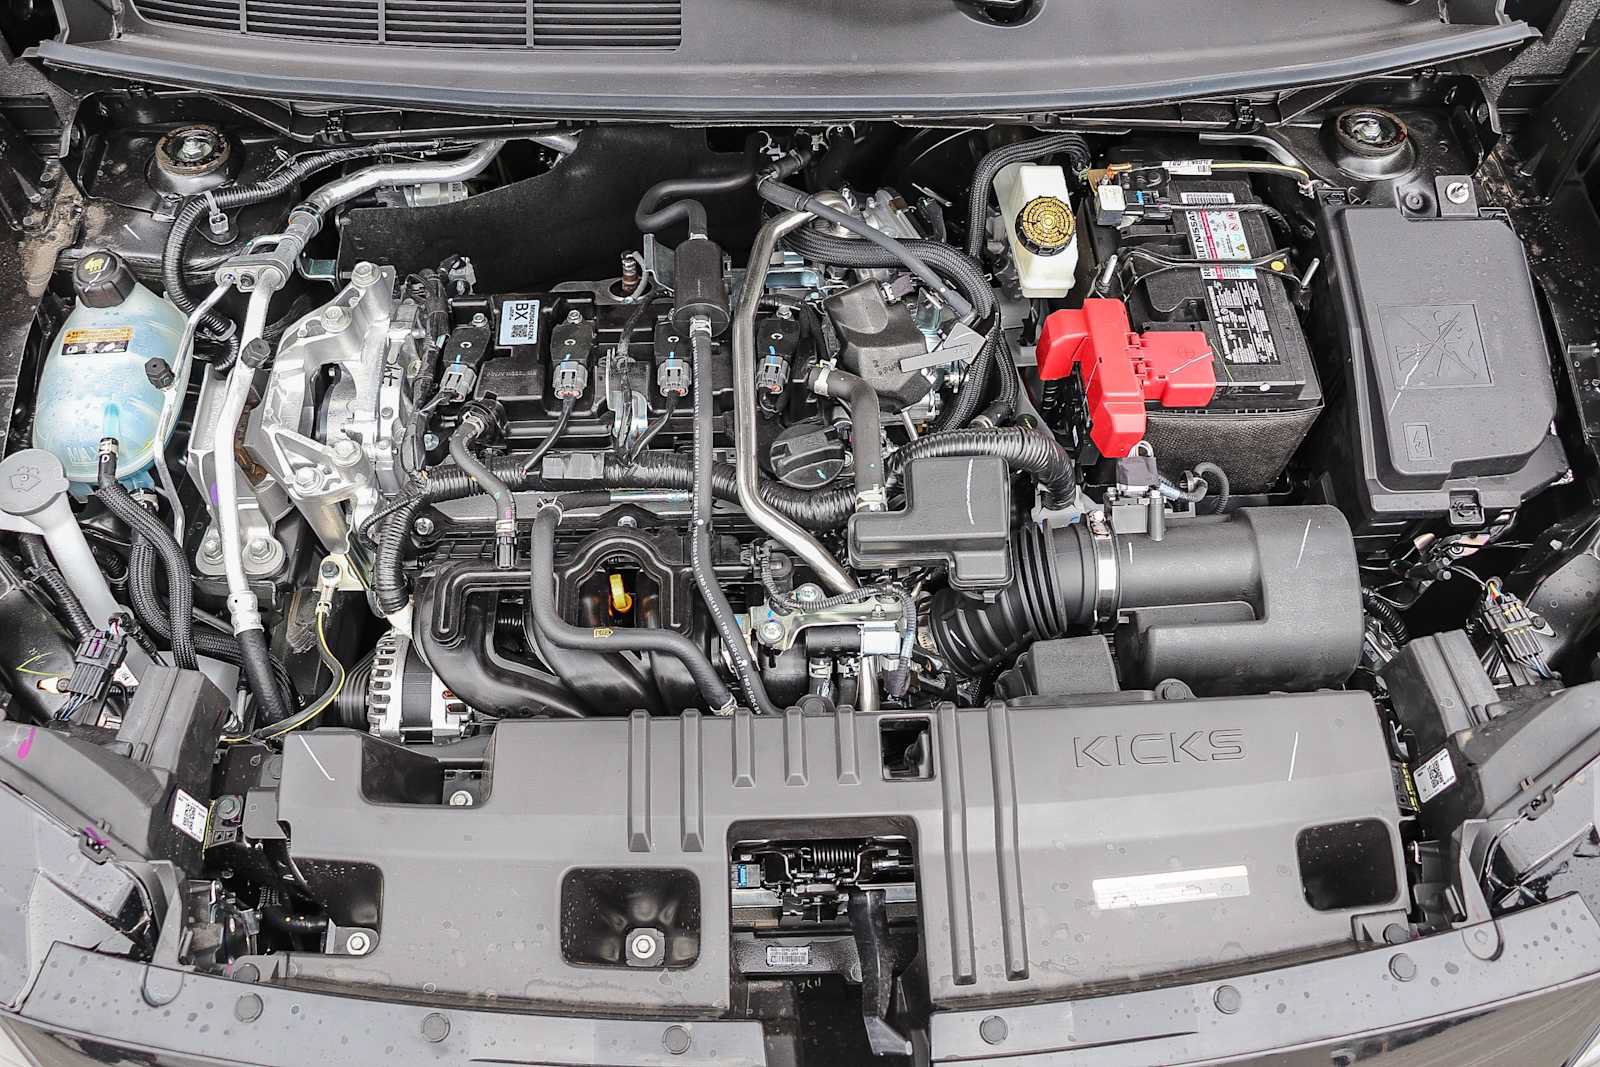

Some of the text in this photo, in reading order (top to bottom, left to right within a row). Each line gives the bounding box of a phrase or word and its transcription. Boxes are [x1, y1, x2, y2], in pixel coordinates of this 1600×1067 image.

[514, 303, 529, 321] BX
[101, 454, 110, 464] D
[1073, 728, 1247, 768] KICKS
